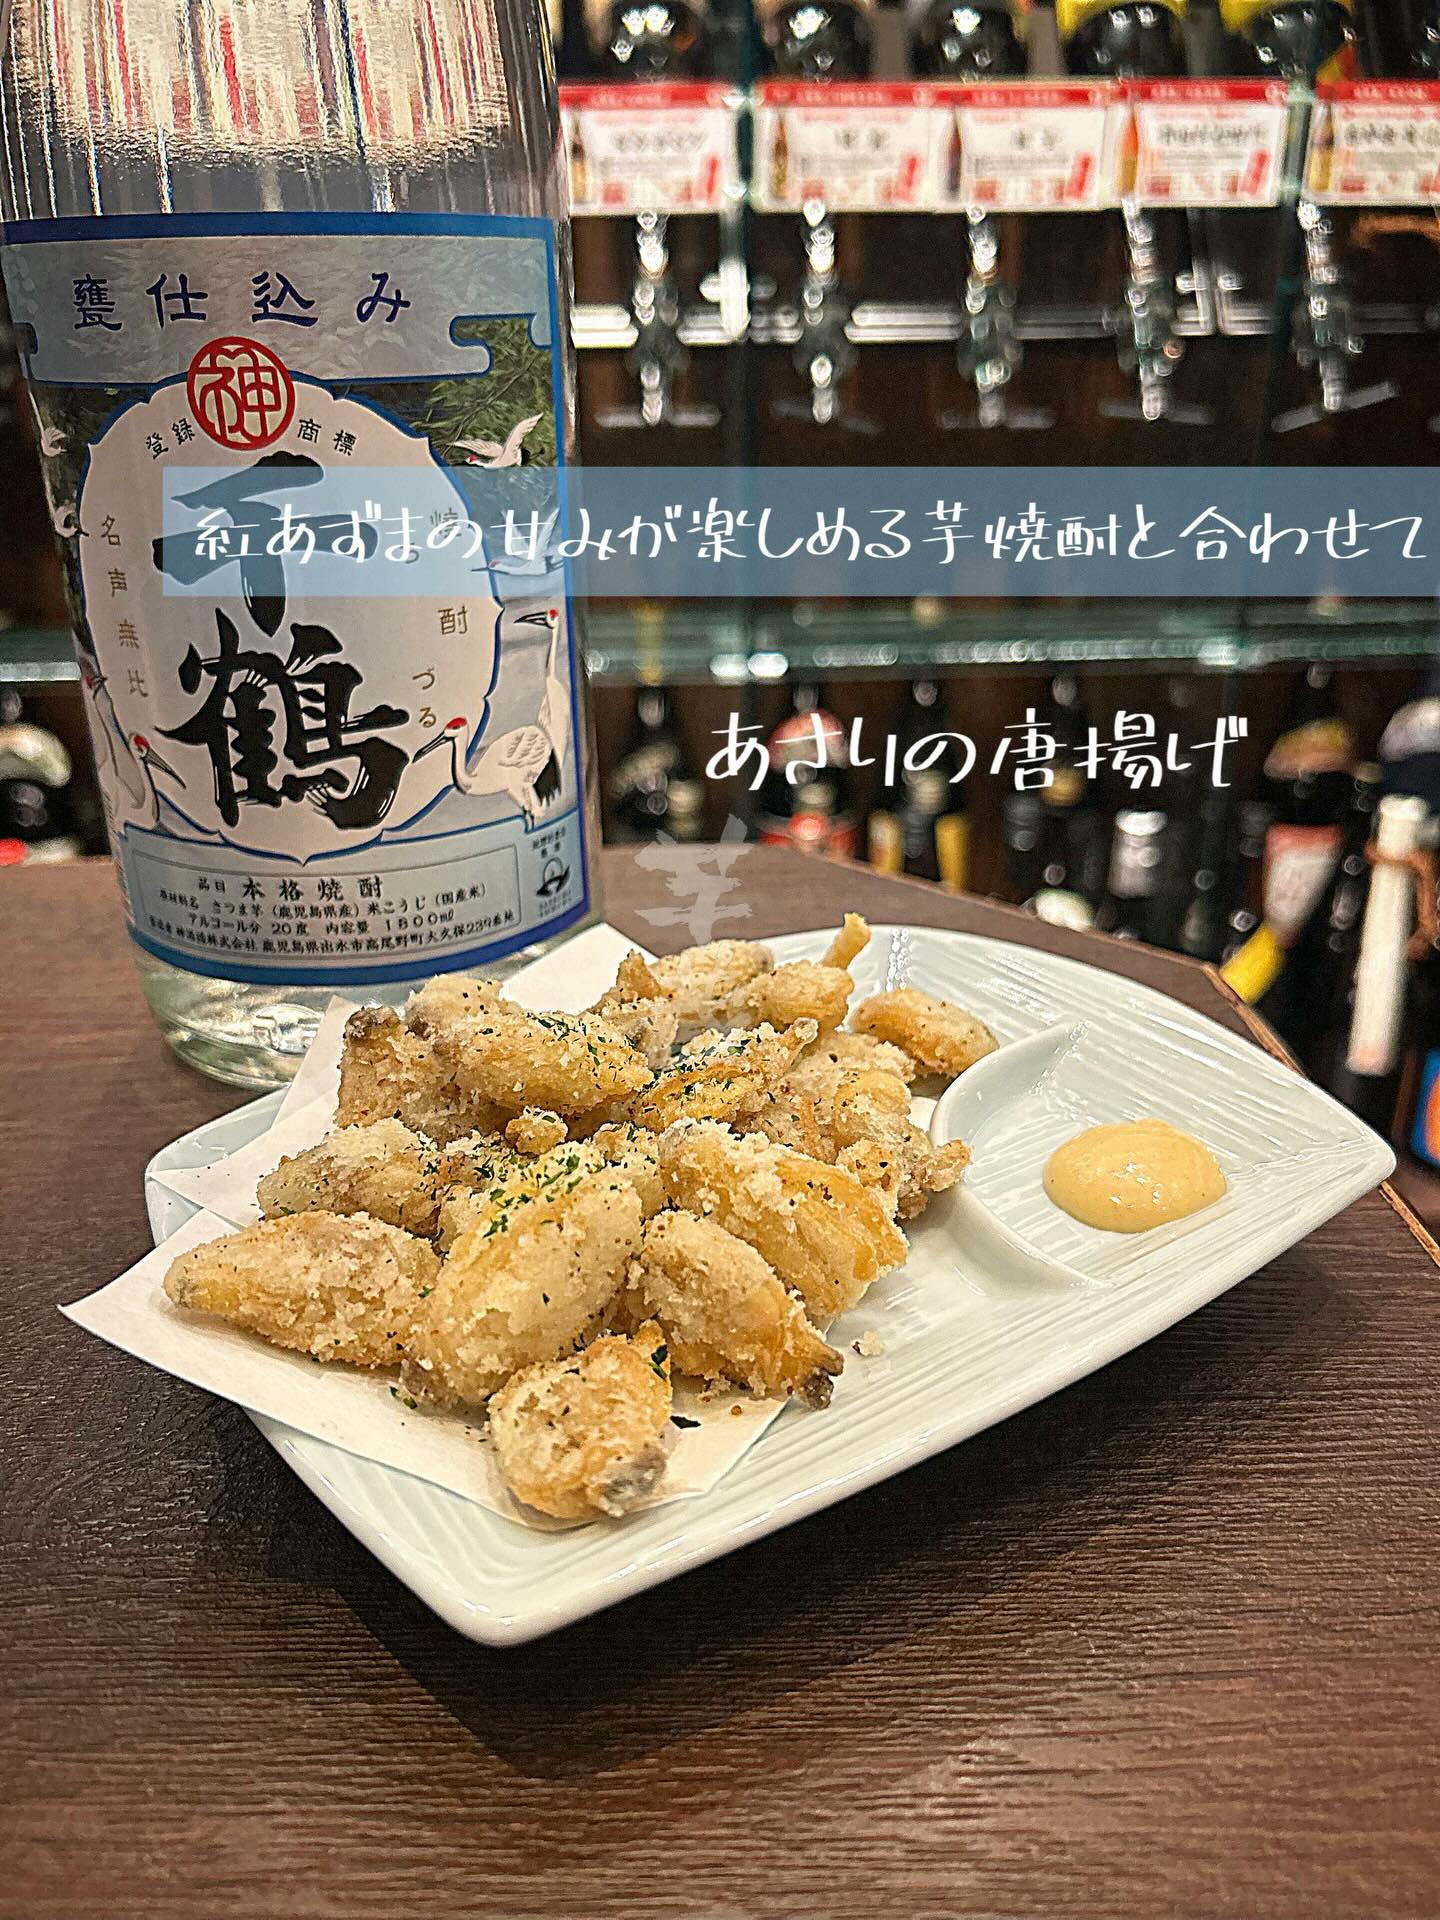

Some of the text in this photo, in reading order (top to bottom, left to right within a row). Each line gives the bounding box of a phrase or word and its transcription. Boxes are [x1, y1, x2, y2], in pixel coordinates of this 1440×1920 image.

[73, 271, 411, 330] 甕仕込み
[187, 337, 295, 449] 神
[145, 418, 357, 459] 登録 商標
[101, 514, 149, 698] 名声無比
[243, 875, 383, 901] 本格焼酎
[189, 912, 262, 935] アルコール分
